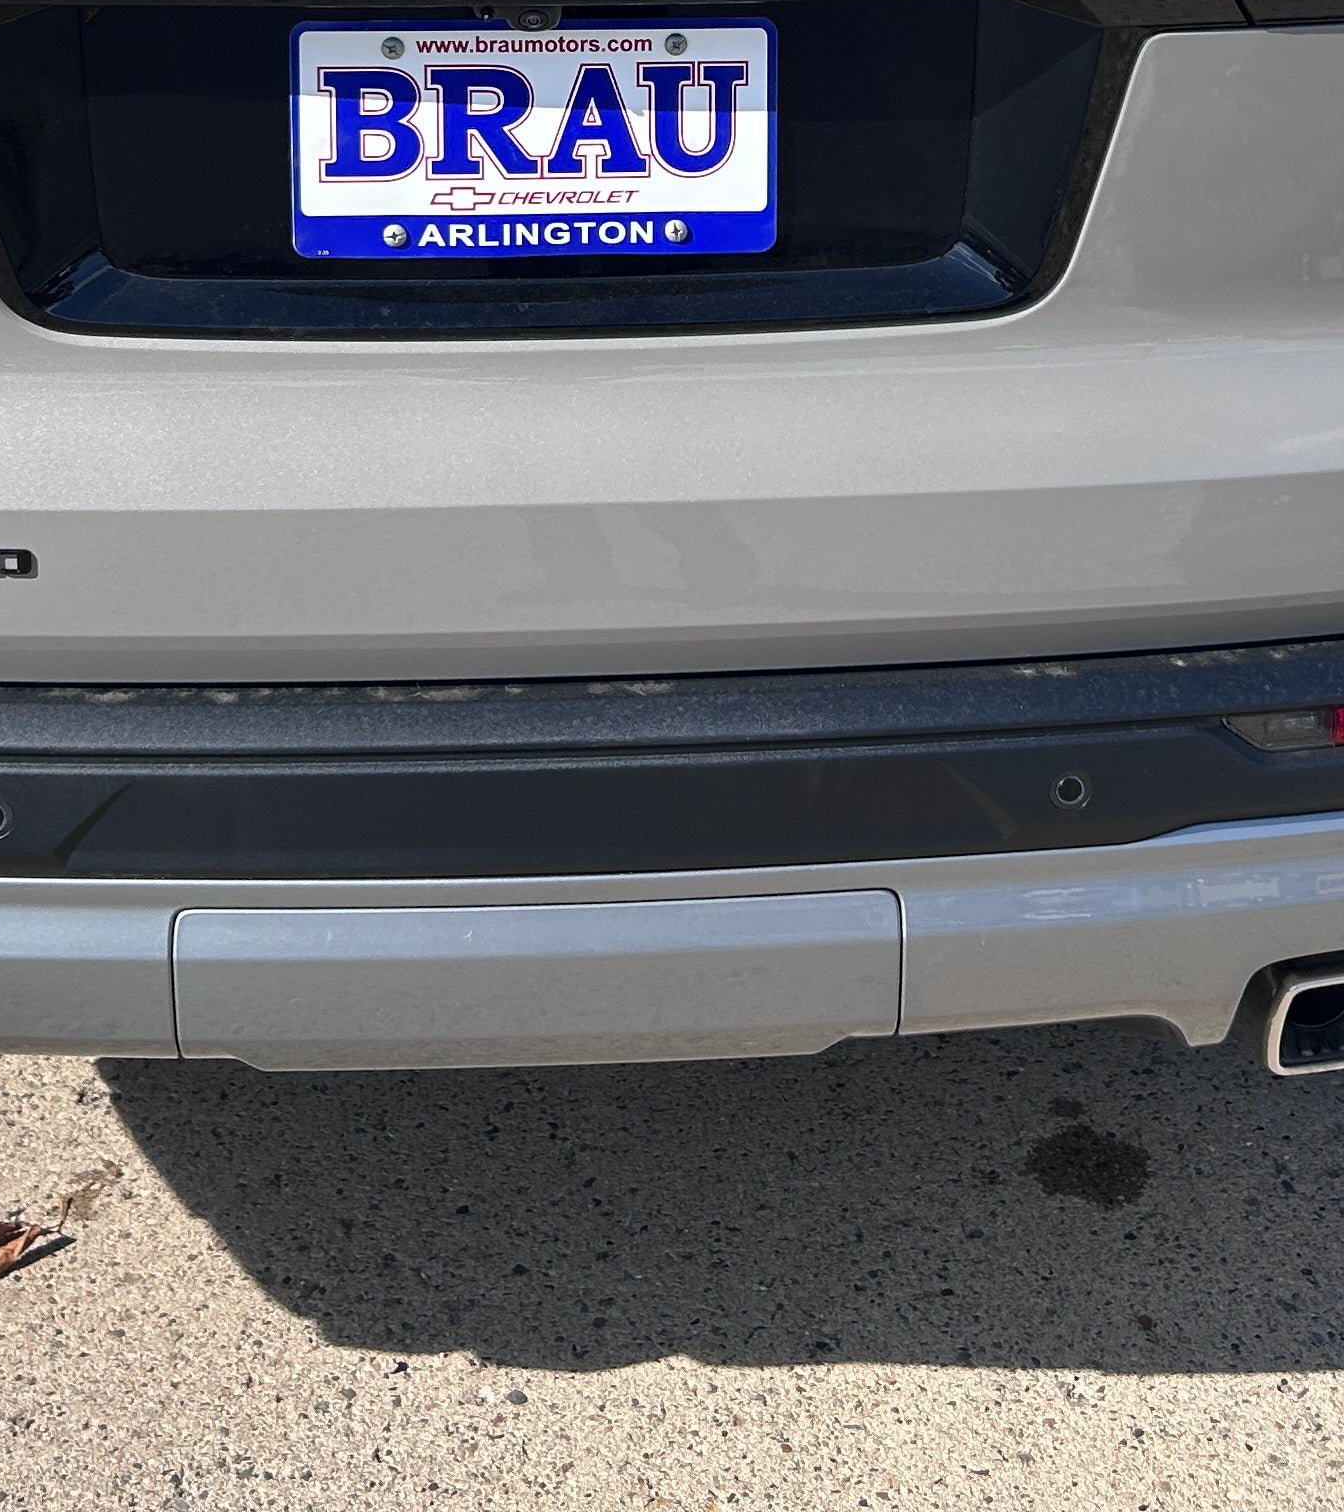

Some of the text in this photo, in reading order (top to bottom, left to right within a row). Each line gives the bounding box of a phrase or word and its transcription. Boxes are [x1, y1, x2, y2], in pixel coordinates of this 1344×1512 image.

[415, 36, 653, 54] www.braumotors.com
[316, 61, 749, 183] BRAU
[498, 189, 640, 205] CHEVROLET
[417, 220, 654, 248] ARLINGTON
